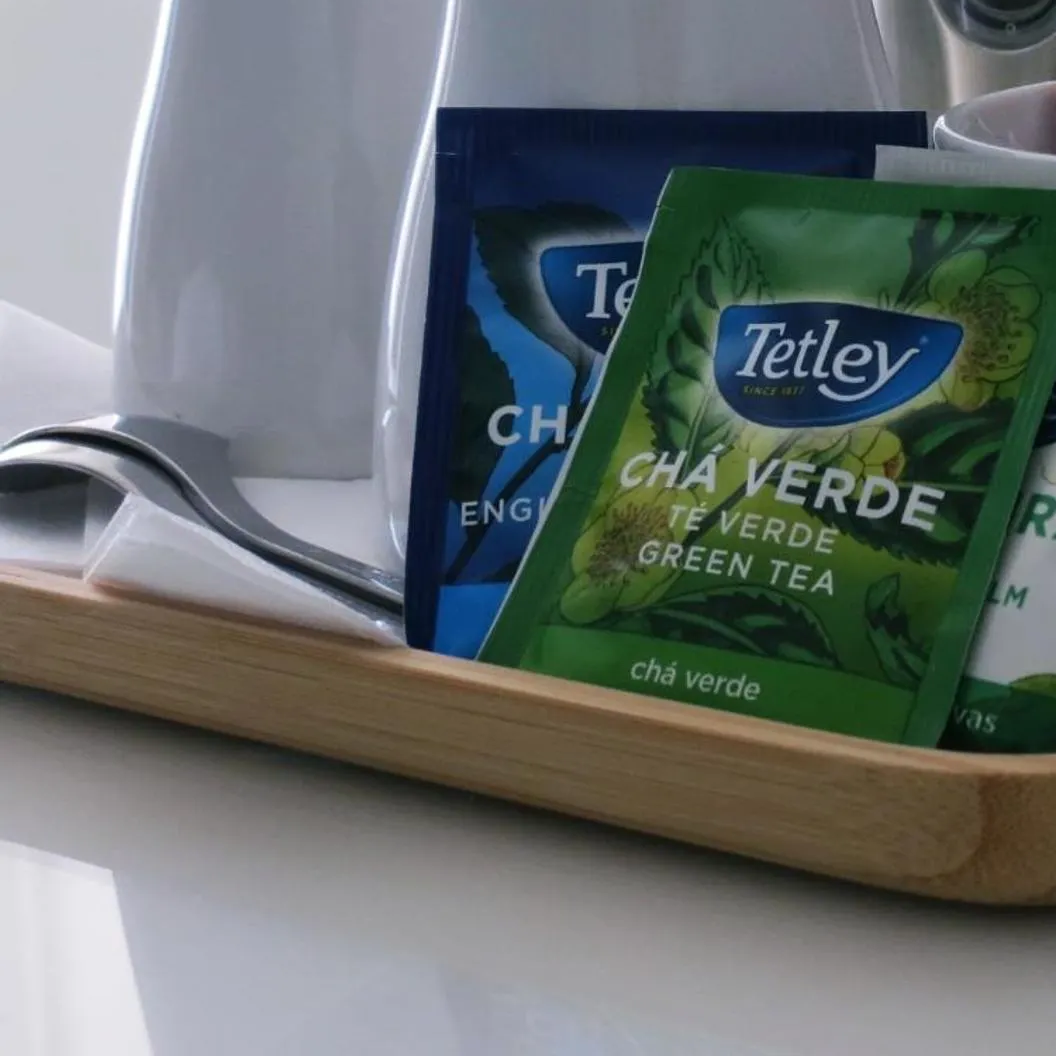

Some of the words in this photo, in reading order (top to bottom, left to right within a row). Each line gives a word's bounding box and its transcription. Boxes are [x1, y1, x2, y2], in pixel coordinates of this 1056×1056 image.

[576, 261, 639, 320] Te
[735, 319, 920, 402] Tetley
[487, 404, 568, 446] CH
[619, 443, 725, 493] CHÁ
[745, 457, 946, 532] VERDE
[669, 502, 708, 531] TÉ
[719, 509, 840, 554] VERDE
[638, 540, 753, 580] GREEN
[770, 558, 834, 595] TEA
[985, 578, 1029, 610] LM
[630, 656, 678, 686] chá
[685, 670, 761, 701] verde
[953, 704, 999, 735] vas
